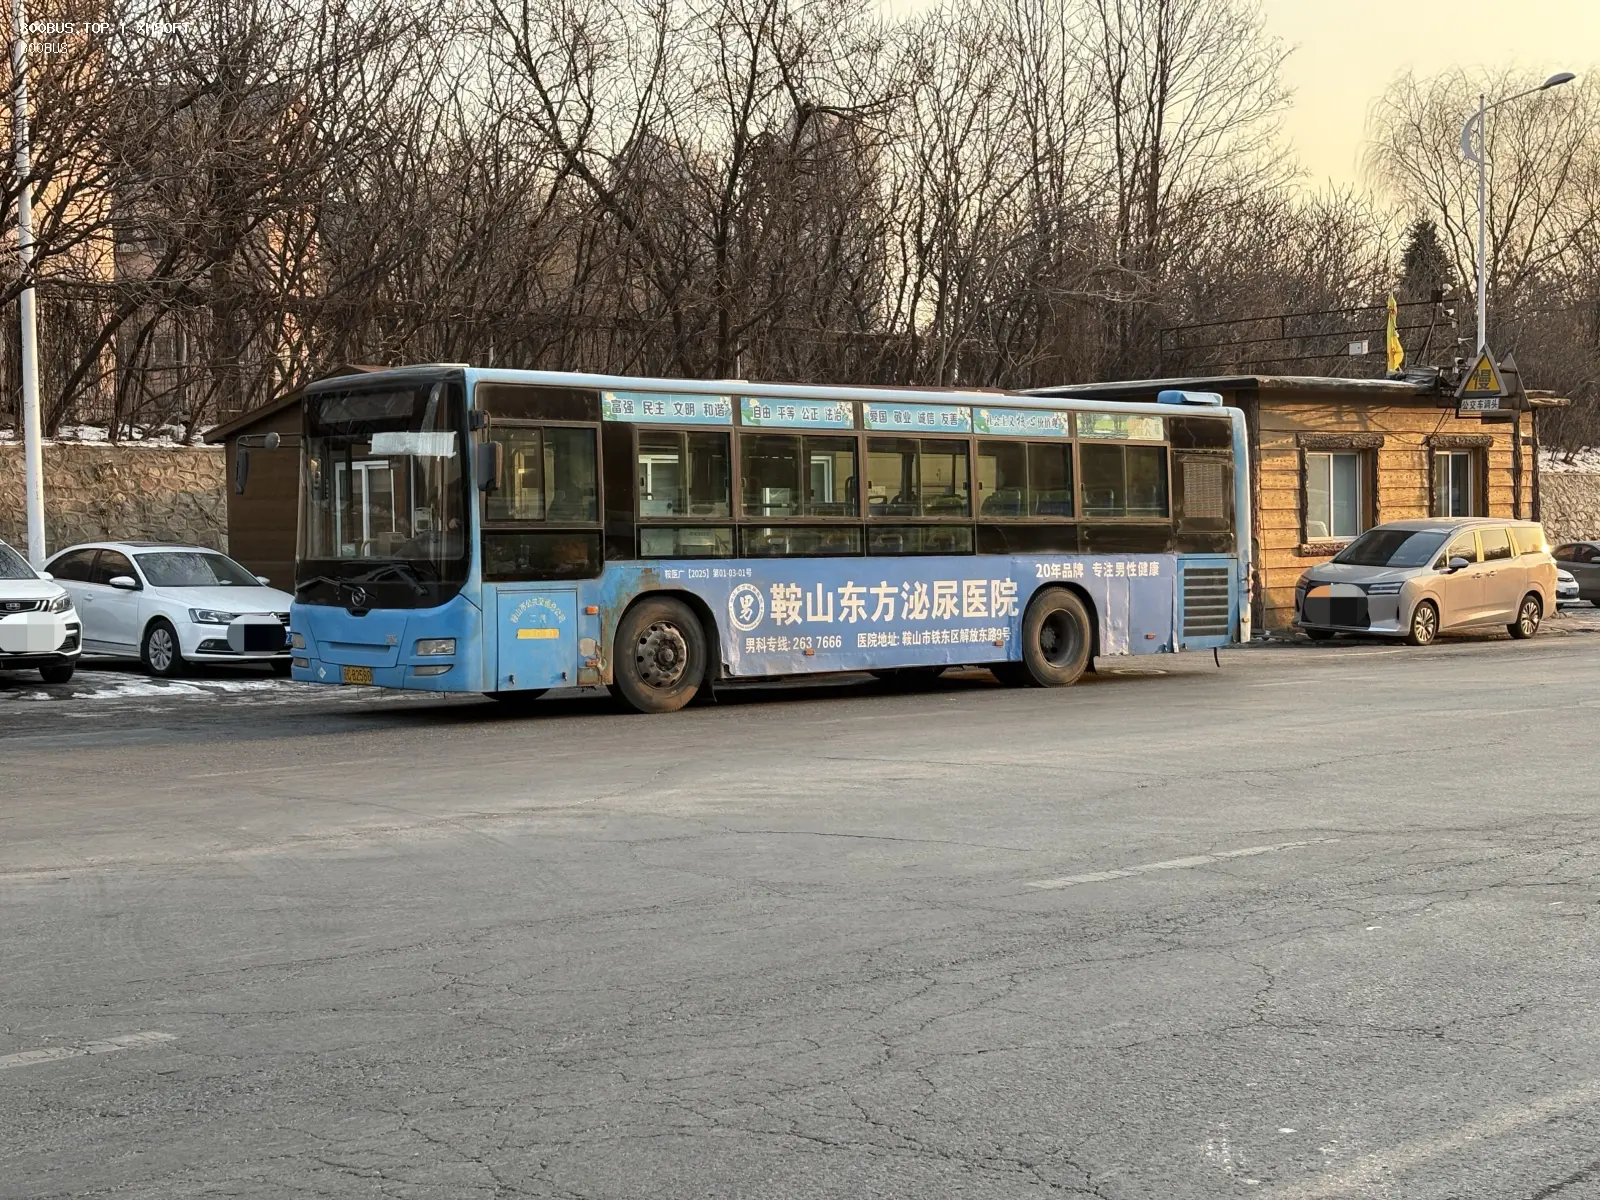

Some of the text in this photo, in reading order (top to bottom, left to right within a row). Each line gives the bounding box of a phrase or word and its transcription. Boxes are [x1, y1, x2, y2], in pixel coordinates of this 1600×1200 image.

[1472, 368, 1492, 390] 慢
[612, 400, 725, 417] 富强 民主 文明 和谐
[753, 405, 842, 422] 自由 平等 公正 法治
[869, 410, 958, 426] 爱国 敬业 诚信 友善
[1035, 561, 1160, 578] 20年品牌 专注男性健康
[769, 579, 1020, 627] 鞍山东方泌尿医院
[792, 636, 813, 651] 263
[816, 634, 842, 649] 7666
[901, 626, 1012, 648] 鞍山市铁东区解放东路9号
